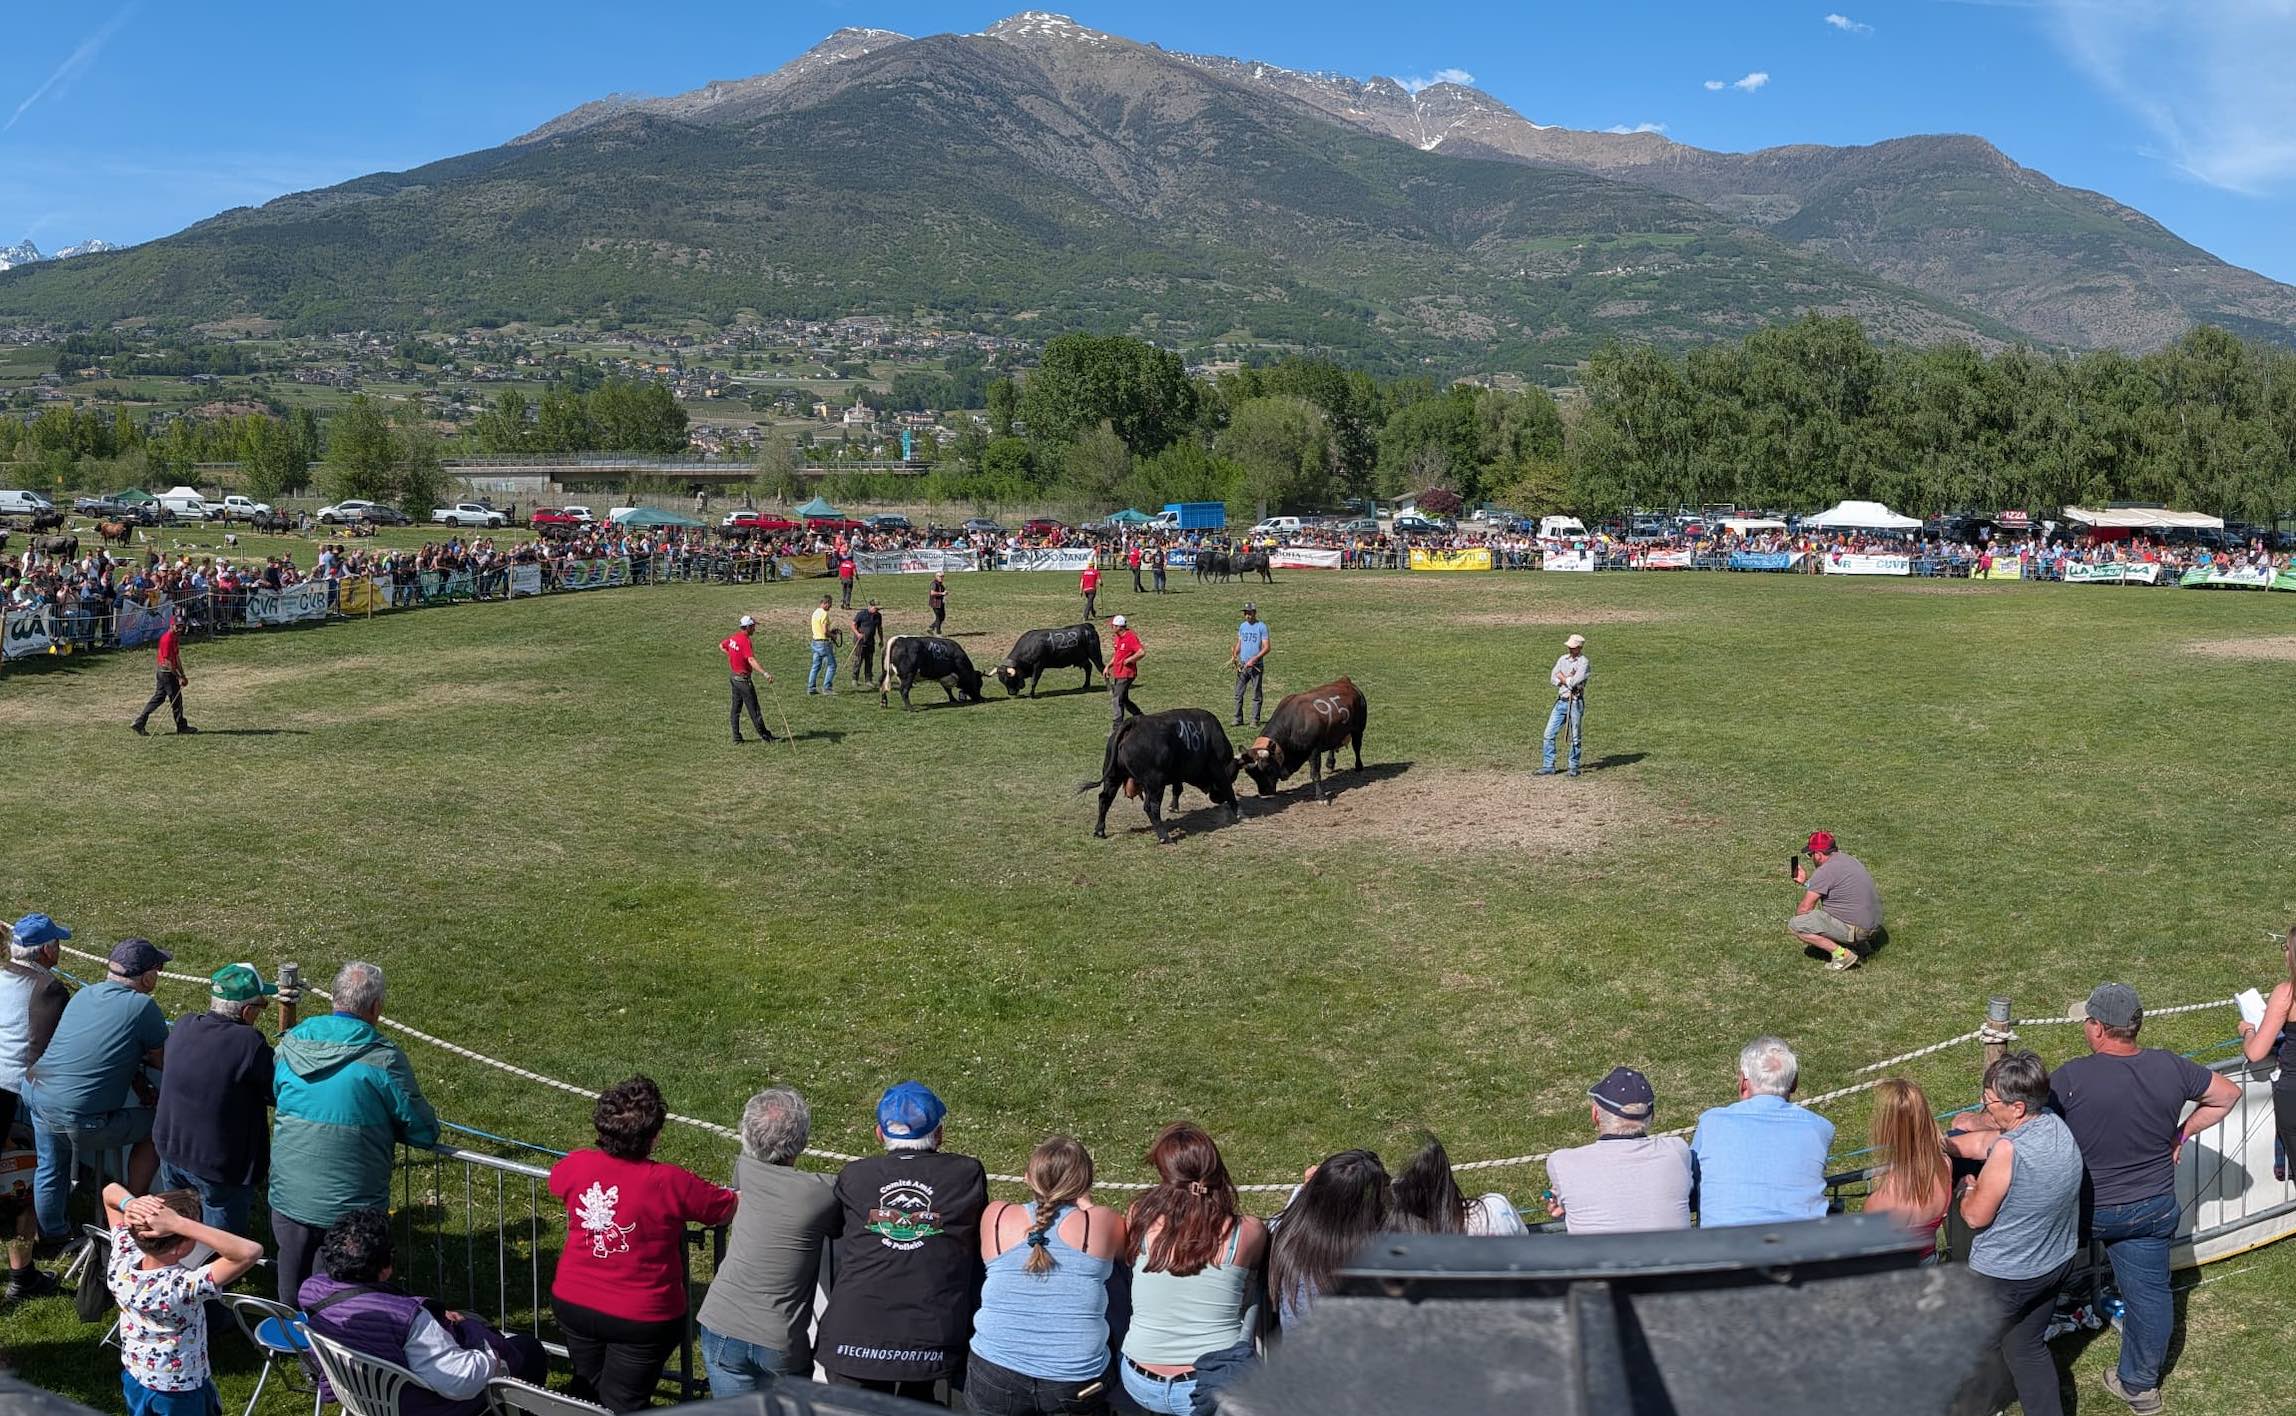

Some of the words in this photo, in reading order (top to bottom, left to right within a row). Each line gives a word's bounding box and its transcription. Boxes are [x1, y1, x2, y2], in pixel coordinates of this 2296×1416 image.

[2000, 511, 2027, 520] PIZZA
[880, 1179, 912, 1194] Comité
[912, 1181, 934, 1196] Amis
[881, 1237, 893, 1248] de
[892, 1240, 925, 1251] Pollein
[837, 1344, 944, 1361] #TECHNOSPORTVDA
